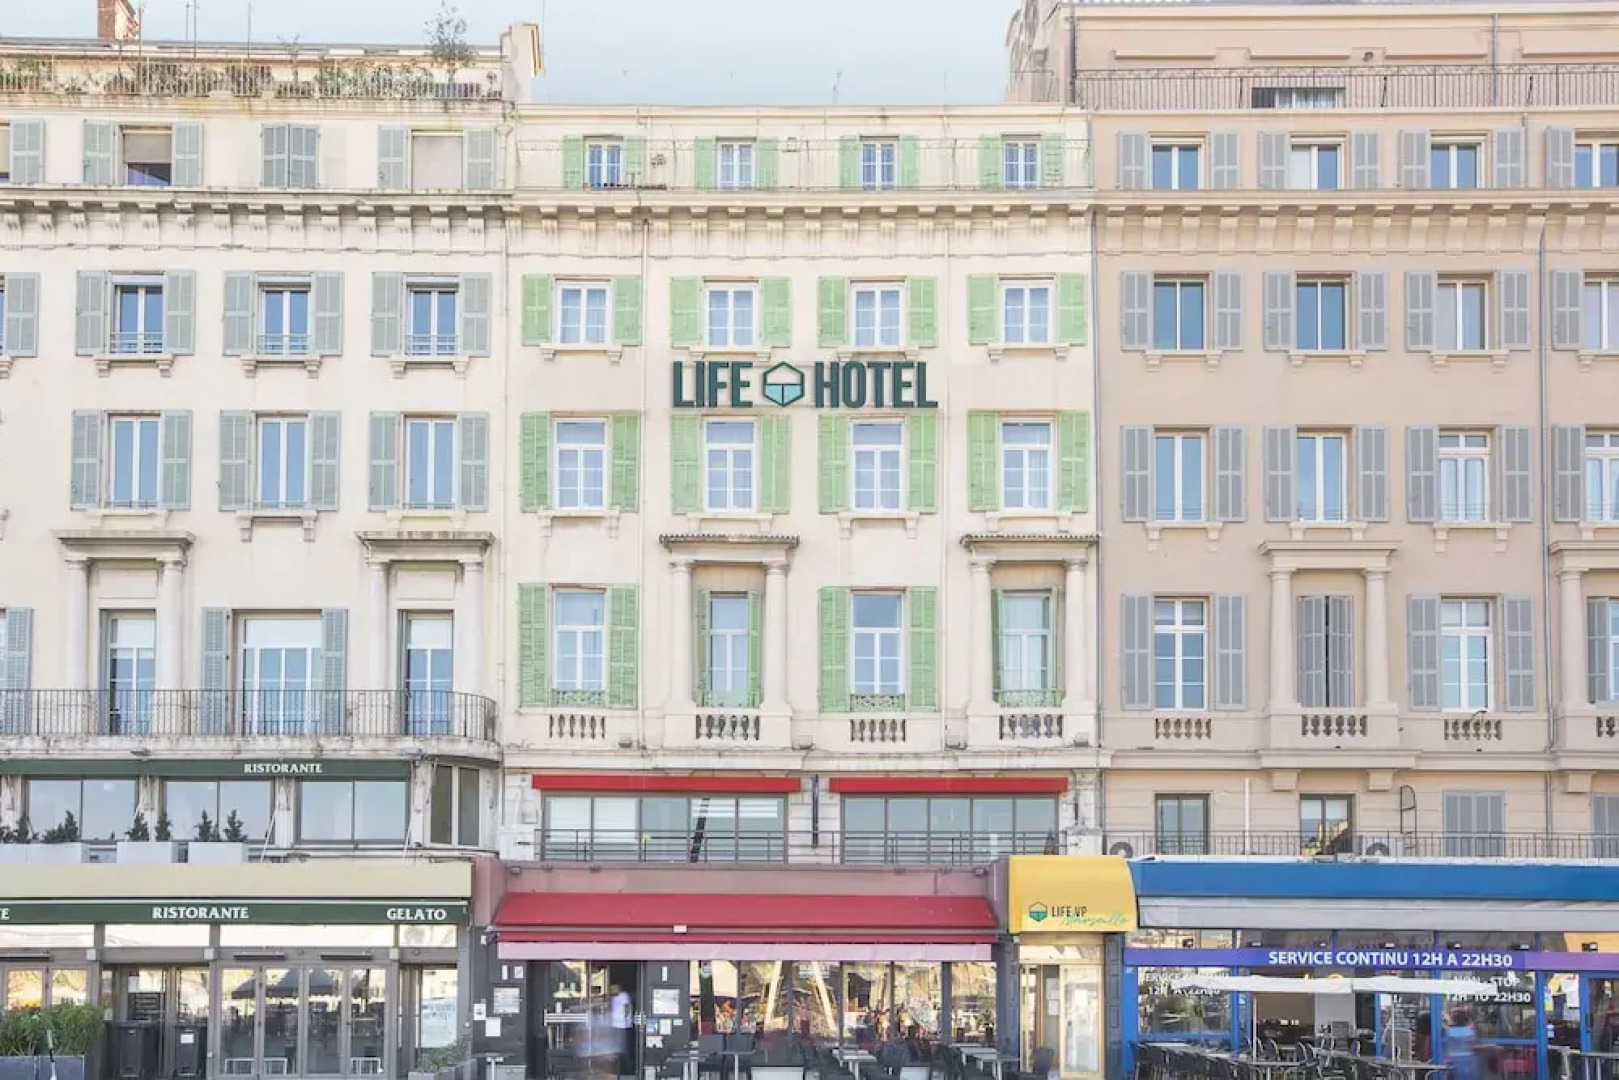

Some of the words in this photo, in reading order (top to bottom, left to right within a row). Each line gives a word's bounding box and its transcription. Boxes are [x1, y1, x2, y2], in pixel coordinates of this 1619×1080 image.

[673, 361, 753, 408] LIFE
[814, 362, 938, 408] HOTEL
[243, 763, 323, 774] RISTORANTE
[152, 906, 249, 919] RISTORANTE
[386, 907, 447, 920] GELATO
[1051, 906, 1072, 918] LIFE
[1268, 951, 1332, 965] SERVICE
[1336, 951, 1408, 965] CONTINU
[1413, 952, 1443, 966] 12H
[1447, 953, 1458, 966] A
[1461, 953, 1513, 967] 22H30
[1493, 992, 1531, 1003] 22H30
